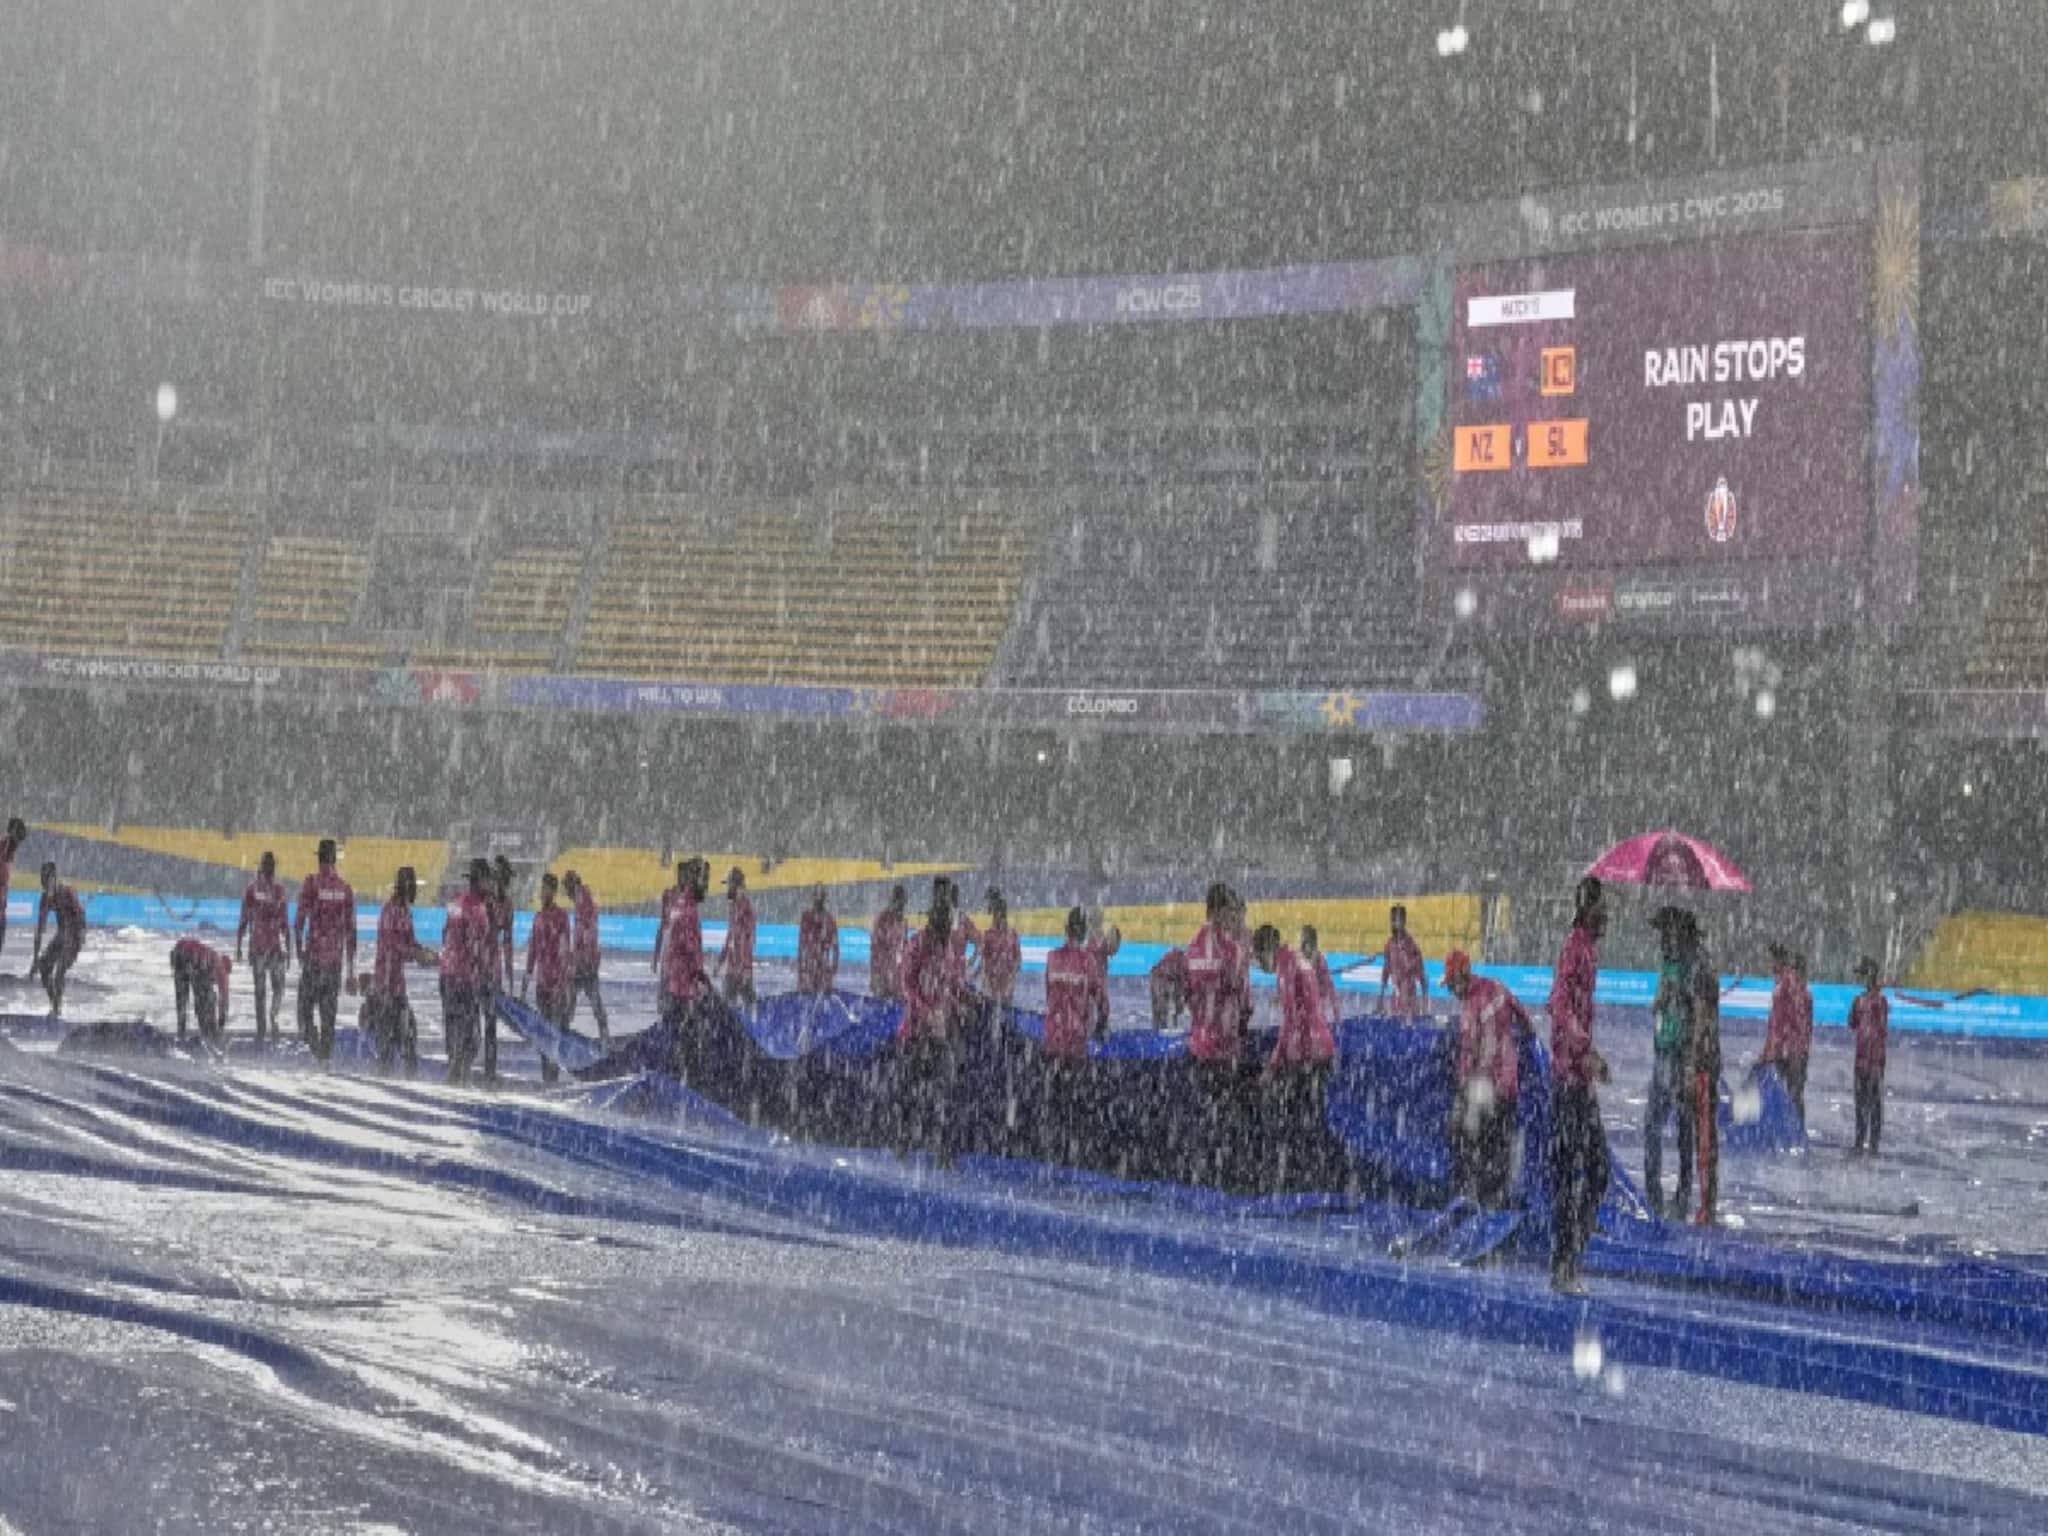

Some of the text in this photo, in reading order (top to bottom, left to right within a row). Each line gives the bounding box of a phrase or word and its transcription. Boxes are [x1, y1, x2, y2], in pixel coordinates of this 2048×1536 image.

[1596, 202, 1680, 230] WOMEN'S
[1684, 196, 1728, 219] CWC
[1732, 189, 1786, 214] 2025
[264, 277, 593, 316] ICC WOMEN'S CRICKET WORLD CUP
[1645, 336, 1805, 387] RAIN STOPS
[1686, 398, 1759, 441] PLAY
[1470, 430, 1494, 463] NZ
[1547, 426, 1567, 457] SL
[1068, 695, 1138, 713] COLOMBO
